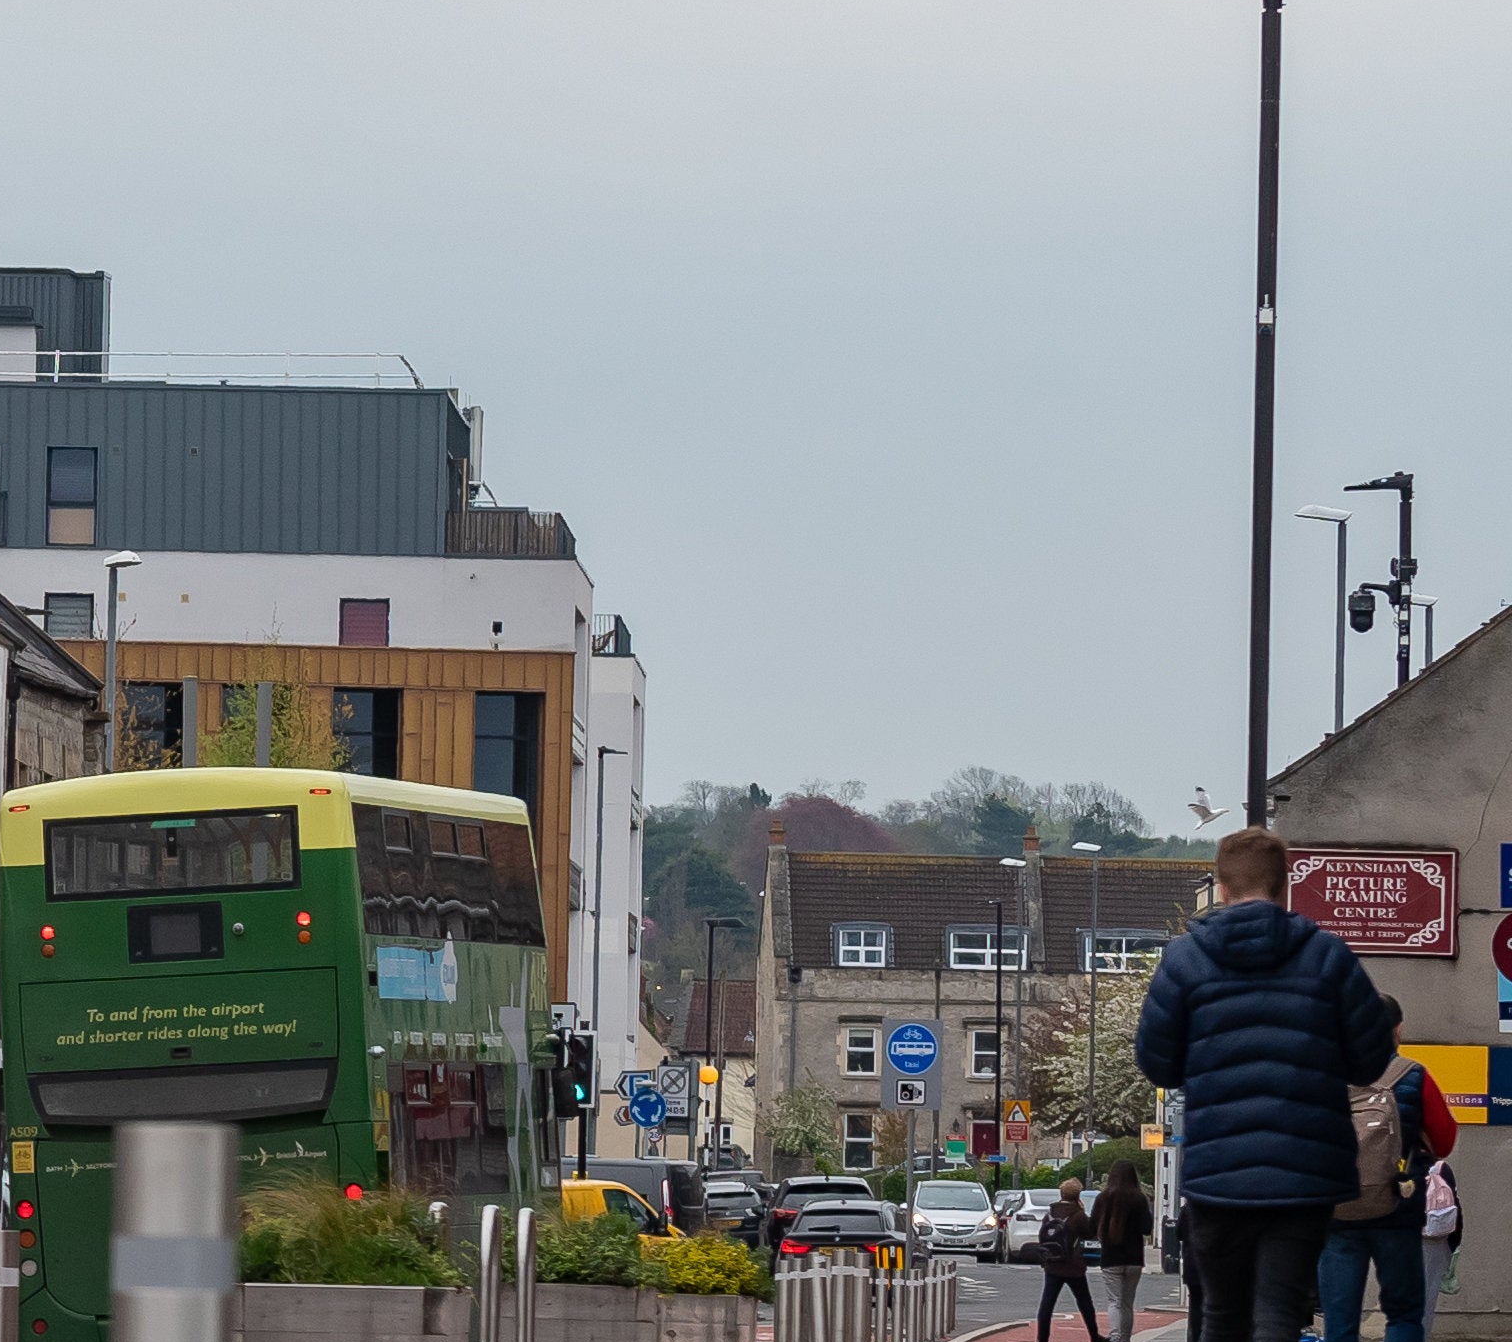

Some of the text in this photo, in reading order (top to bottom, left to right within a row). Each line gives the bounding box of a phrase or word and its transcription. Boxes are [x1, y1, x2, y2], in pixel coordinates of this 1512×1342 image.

[1325, 862, 1407, 874] KEYNSHAM
[1326, 877, 1407, 890] PICTURE
[1325, 890, 1407, 904] FRAMING
[1334, 908, 1397, 919] CENTRE
[87, 1001, 265, 1023] To and from the airport
[56, 1019, 297, 1046] and shorter rides along the way!
[1445, 1095, 1483, 1105] lutions
[666, 1107, 685, 1115] NDS
[10, 1127, 38, 1138] A509
